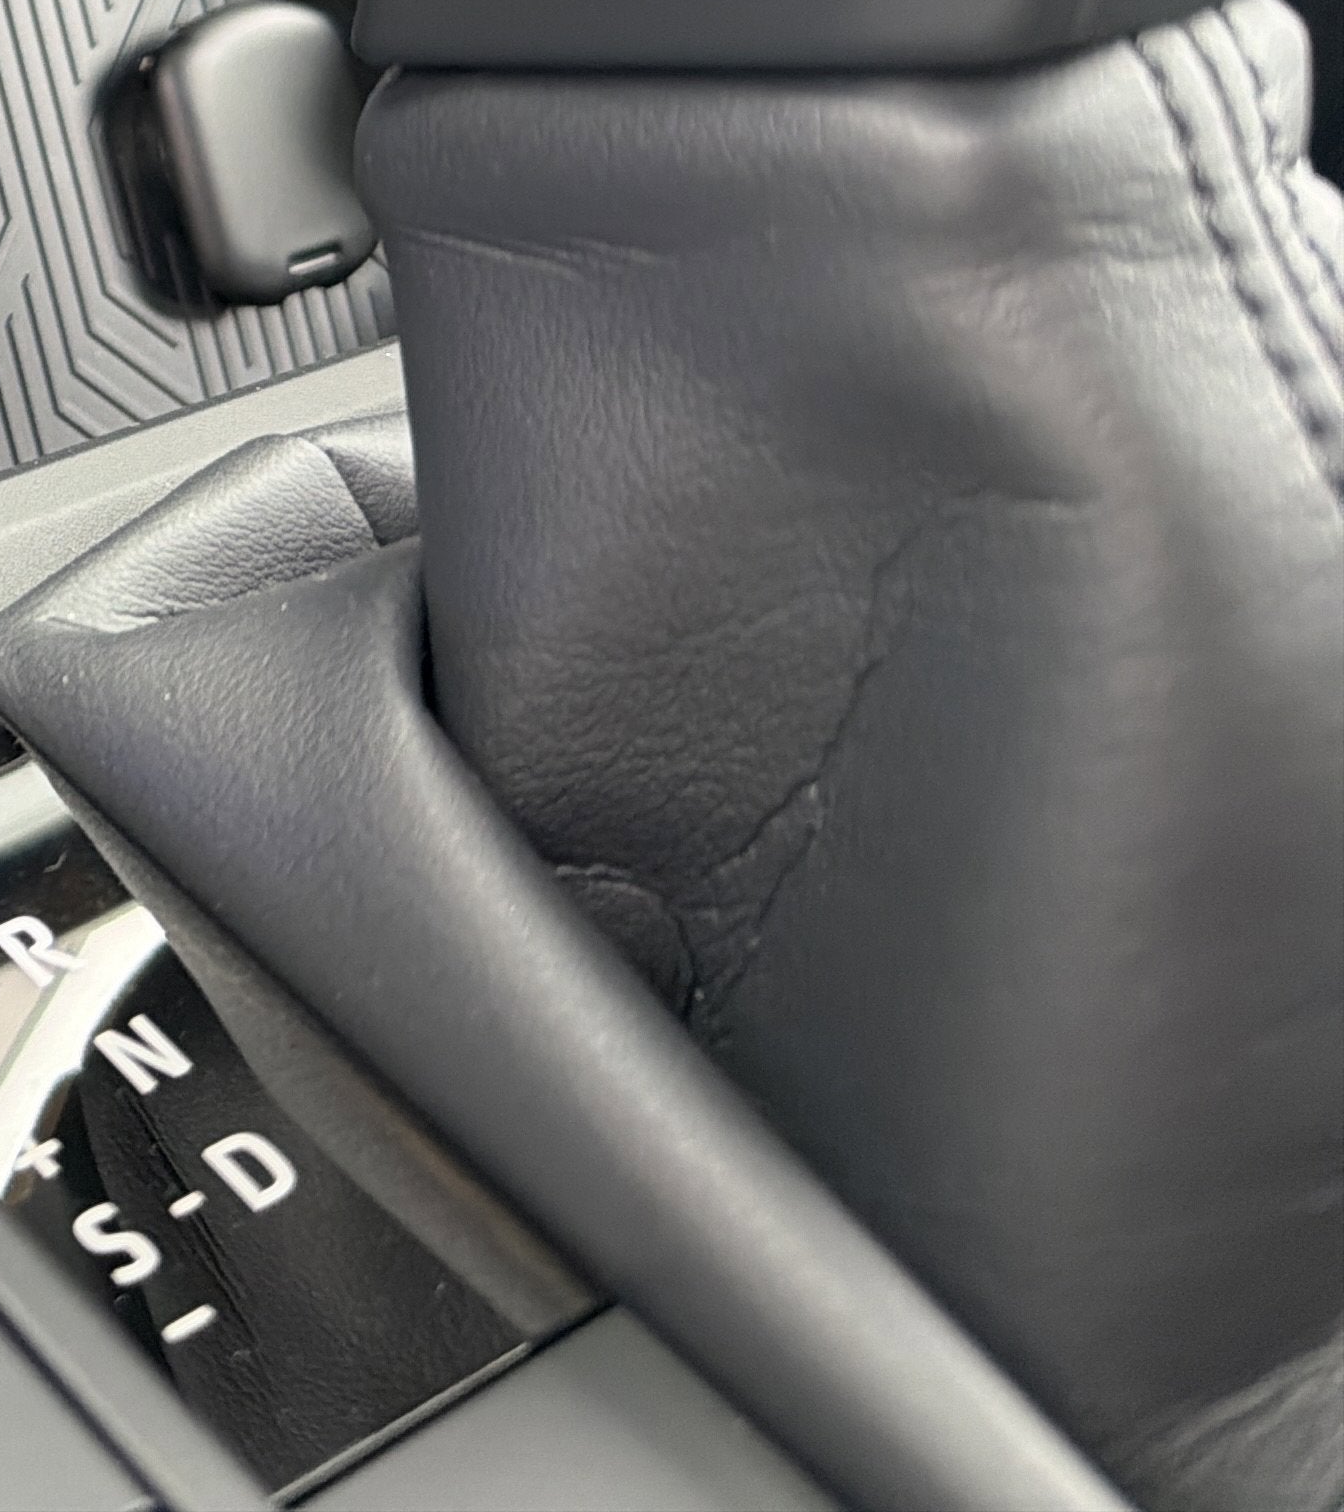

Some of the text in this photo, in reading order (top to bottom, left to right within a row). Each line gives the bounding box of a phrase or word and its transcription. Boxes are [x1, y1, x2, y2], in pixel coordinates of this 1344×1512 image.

[93, 1014, 194, 1095] N
[201, 1131, 297, 1212] D
[72, 1201, 161, 1286] S
